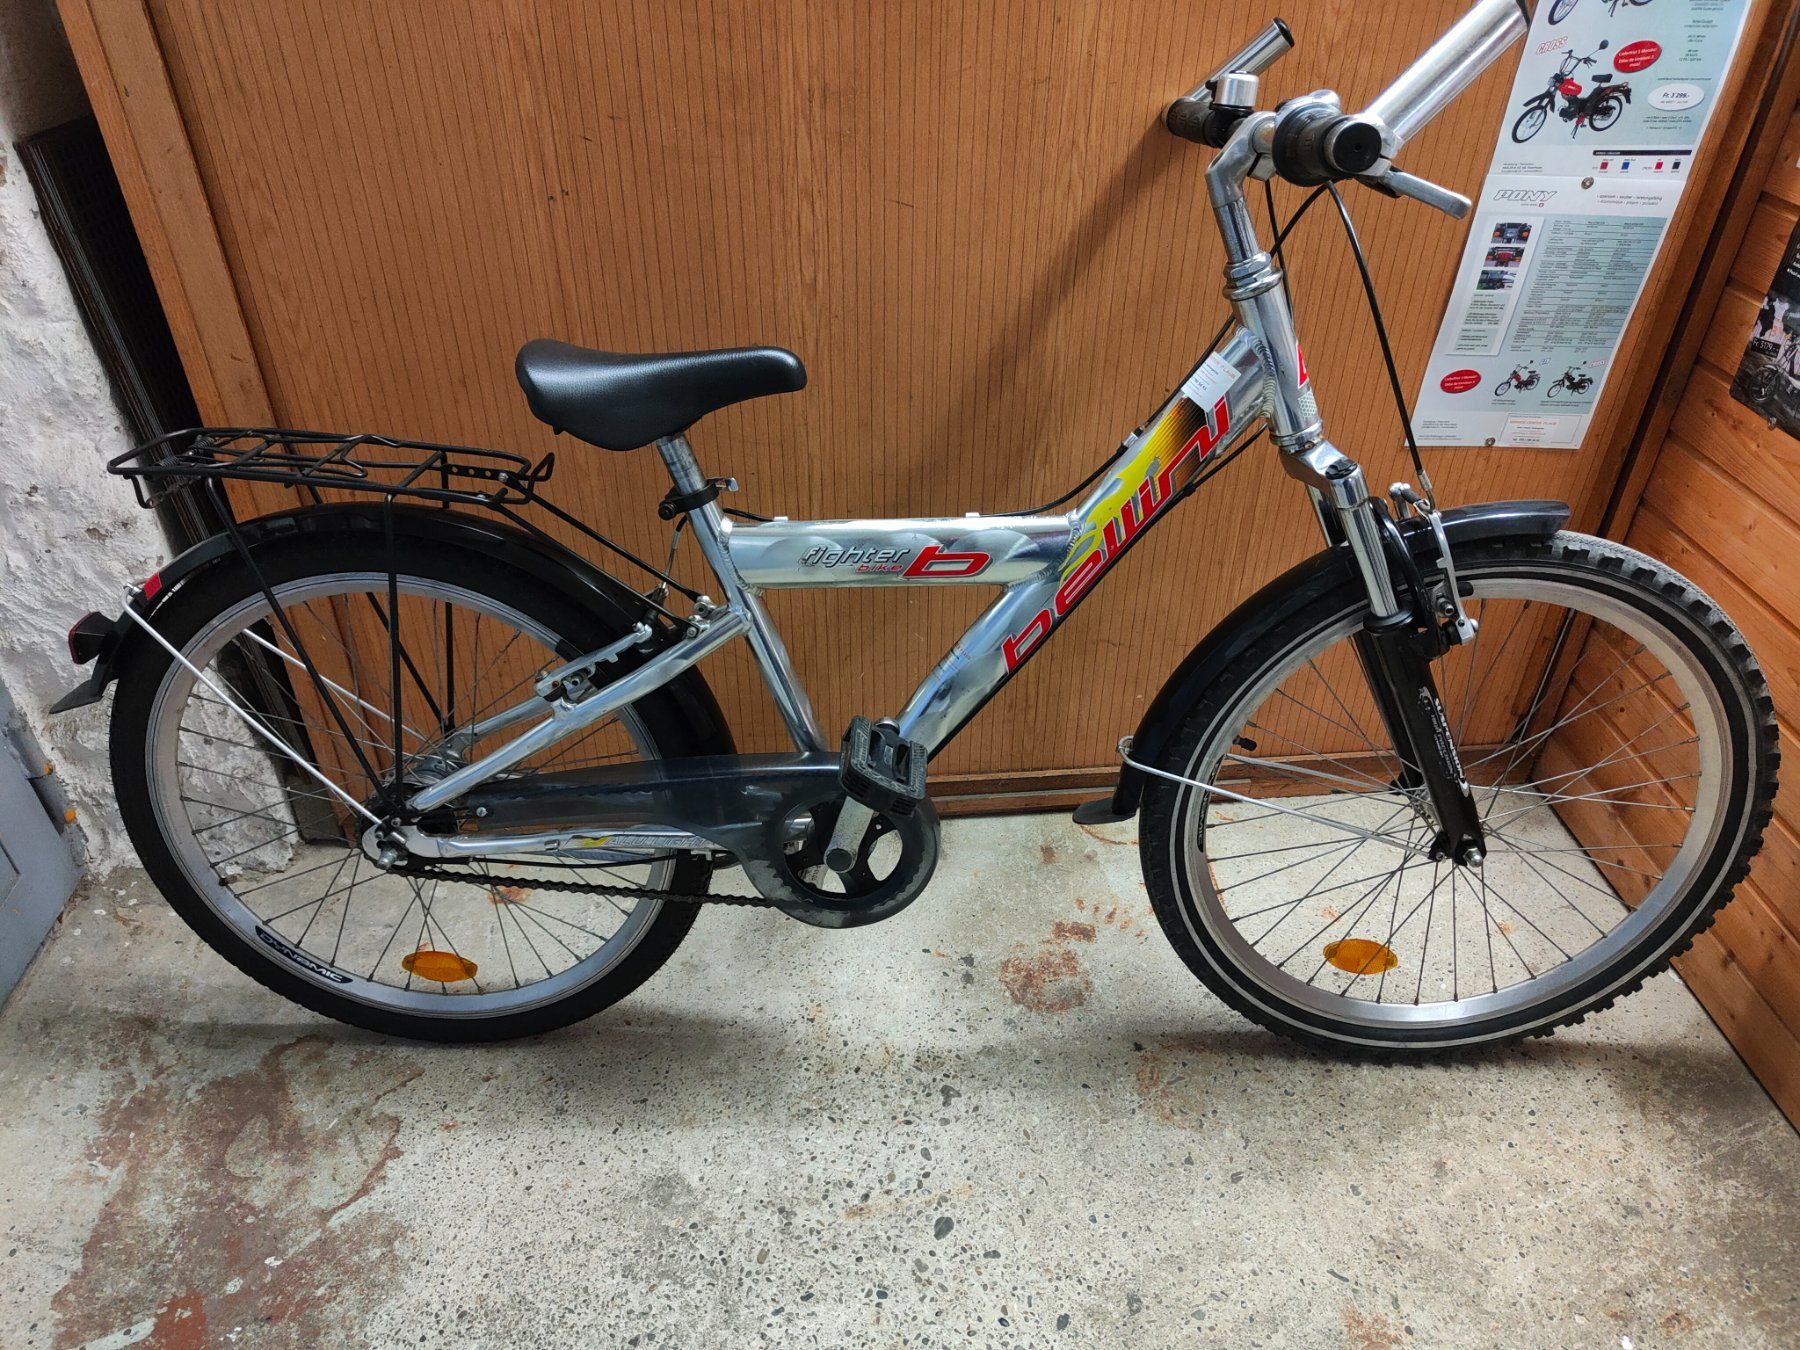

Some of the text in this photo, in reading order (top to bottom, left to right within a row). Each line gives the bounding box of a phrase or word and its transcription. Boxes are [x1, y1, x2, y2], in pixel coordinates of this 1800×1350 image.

[1493, 189, 1558, 202] PONY
[1001, 394, 1231, 674] bellini
[806, 546, 911, 569] fighter
[855, 563, 903, 574] bike
[1434, 697, 1466, 780] SUSPENSION
[259, 932, 343, 983] DYNAMIC
